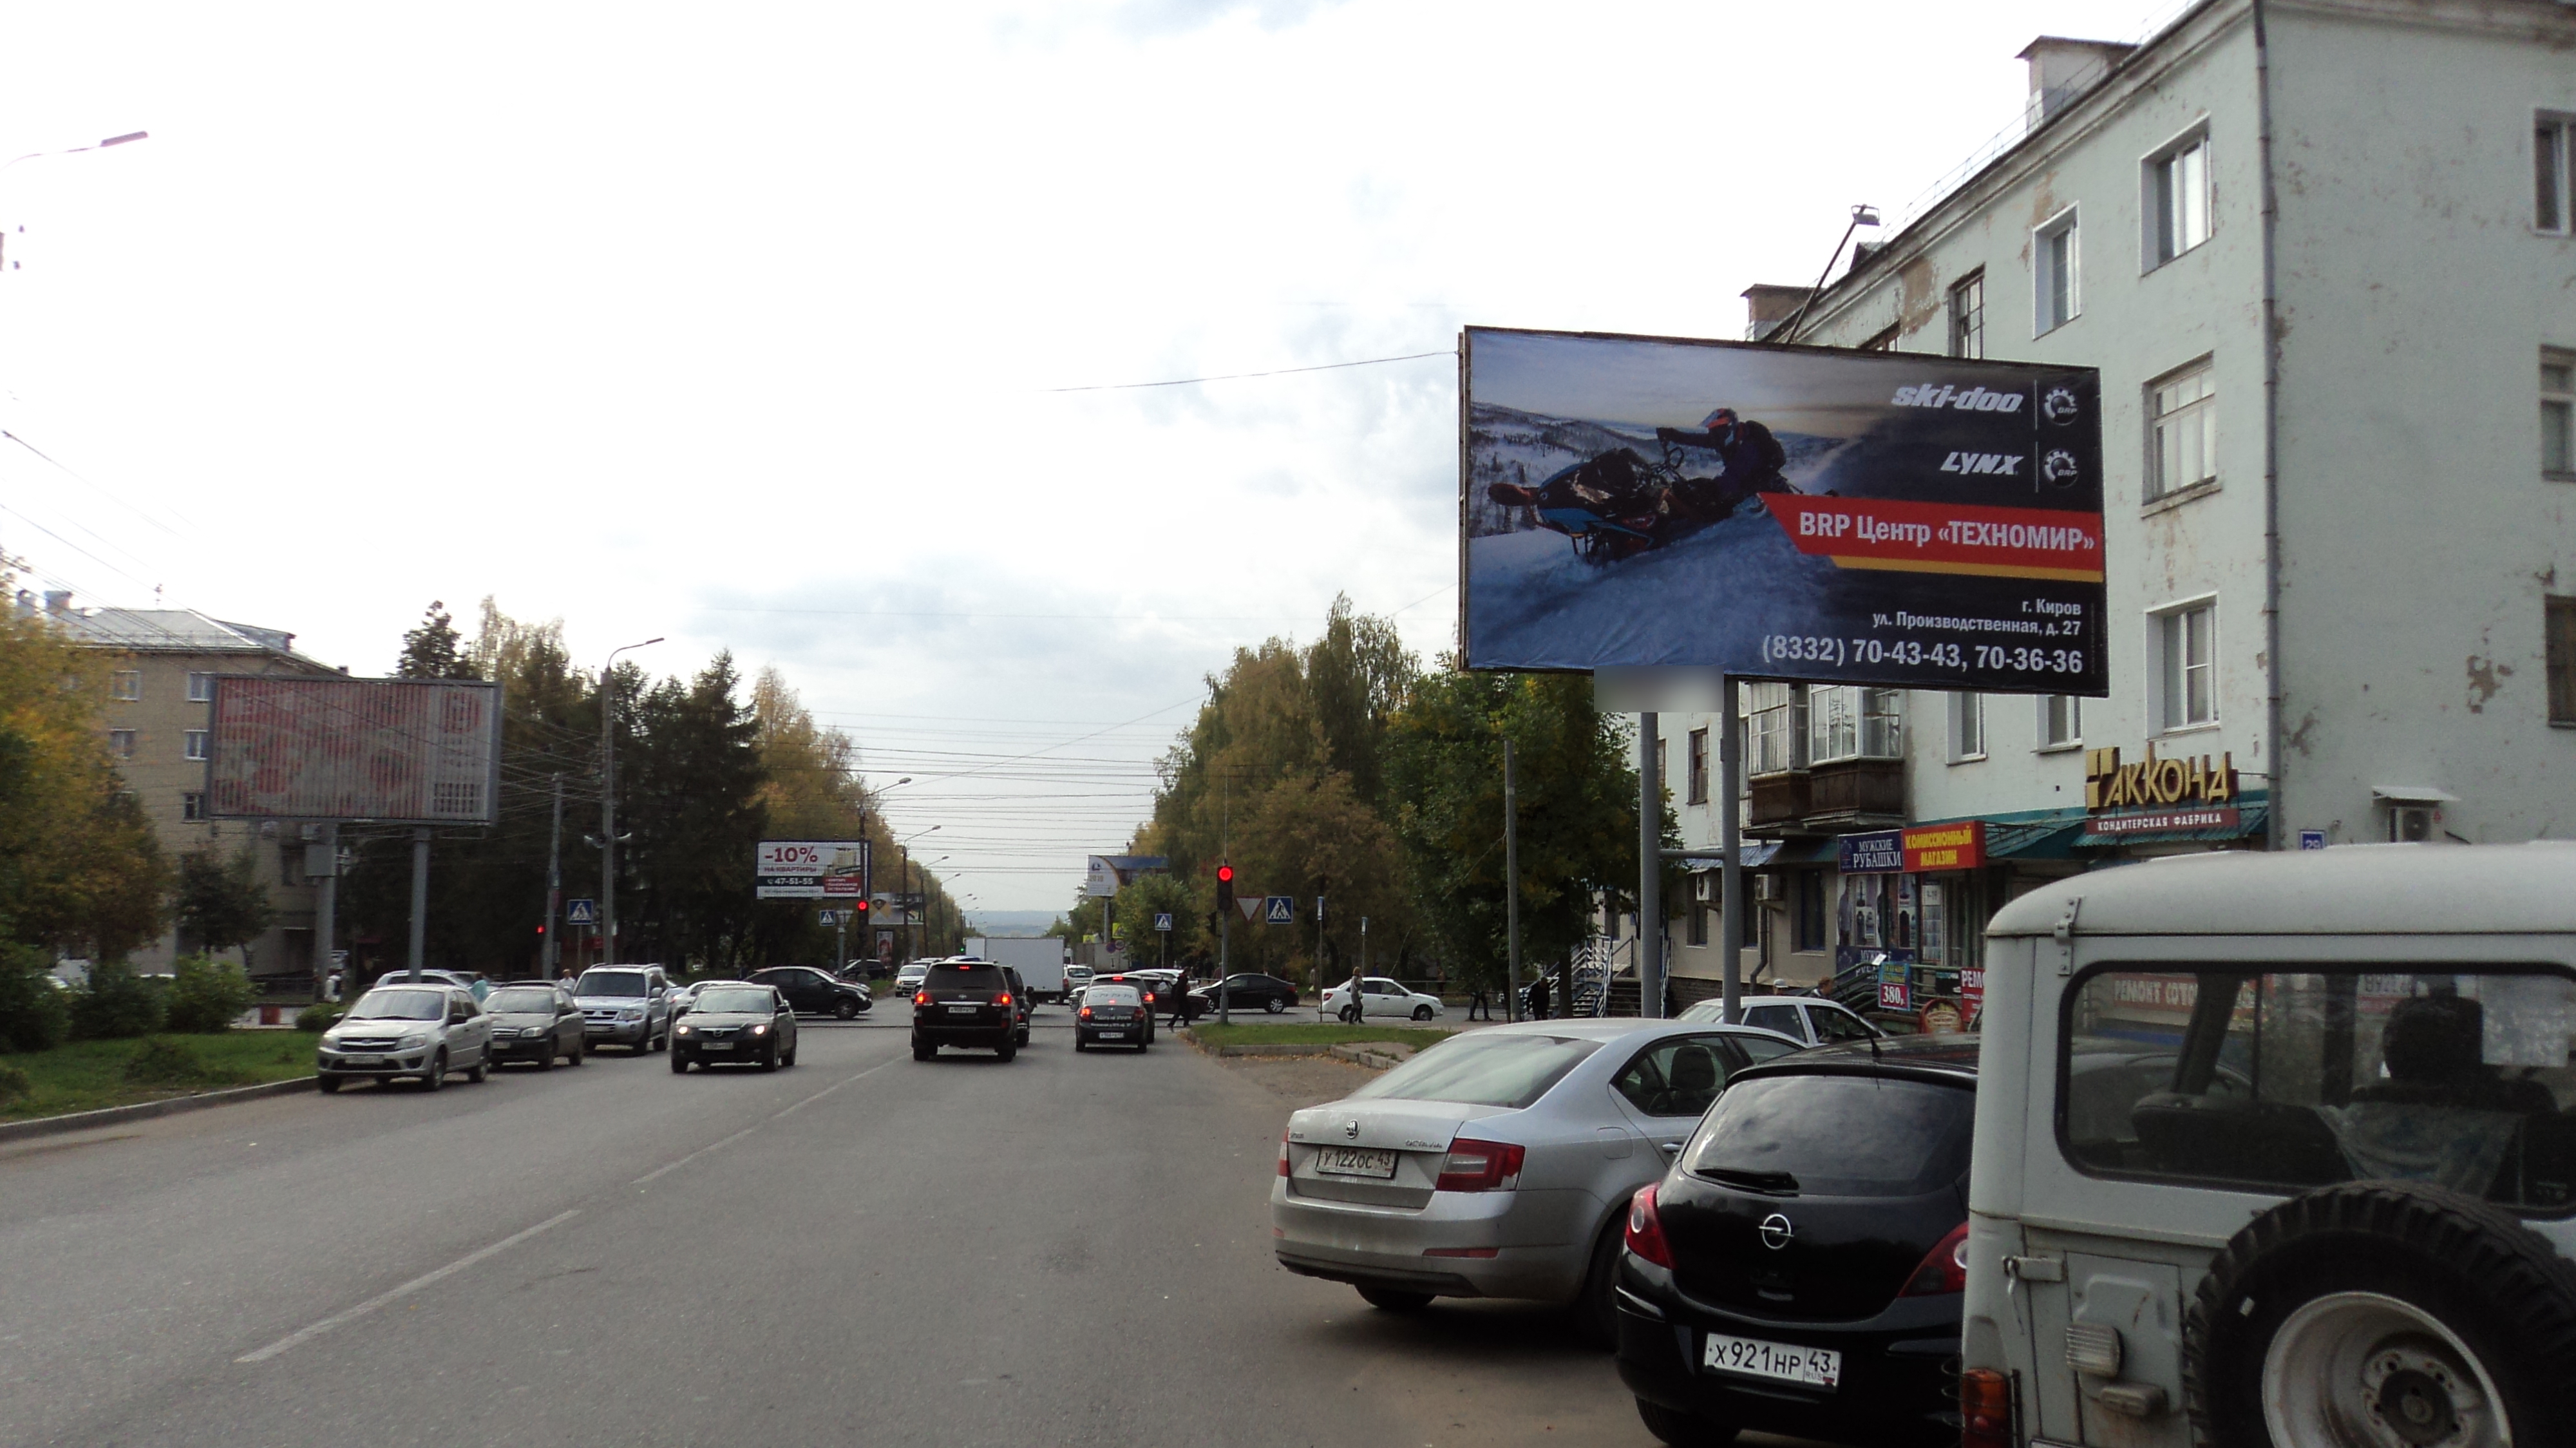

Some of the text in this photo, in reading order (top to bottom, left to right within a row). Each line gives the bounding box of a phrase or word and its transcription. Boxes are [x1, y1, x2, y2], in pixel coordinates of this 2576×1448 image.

[1891, 383, 2023, 413] ski-doo
[1940, 451, 2024, 475] LYNX
[1799, 511, 2096, 551] BRP Центр «ТЕХНОМИР»
[2022, 598, 2082, 618] г. Киров
[1872, 611, 2081, 636] ул. Производственная, д. 27
[1762, 634, 2083, 674] (8332) 70-43-43, 70-36-36
[2097, 812, 2222, 832] КОНДИТЕРСКАЯ ФАБРИКА
[764, 846, 819, 864] -10%
[1859, 838, 1894, 853] МУЖСКИЕ
[1853, 850, 1902, 869] РУБАШКИ
[1920, 849, 1958, 867] МАГАЗИН
[1961, 969, 1985, 989] РЕМ
[2114, 979, 2162, 1004] РЕМОНТ
[1804, 1371, 1823, 1382] RUS
